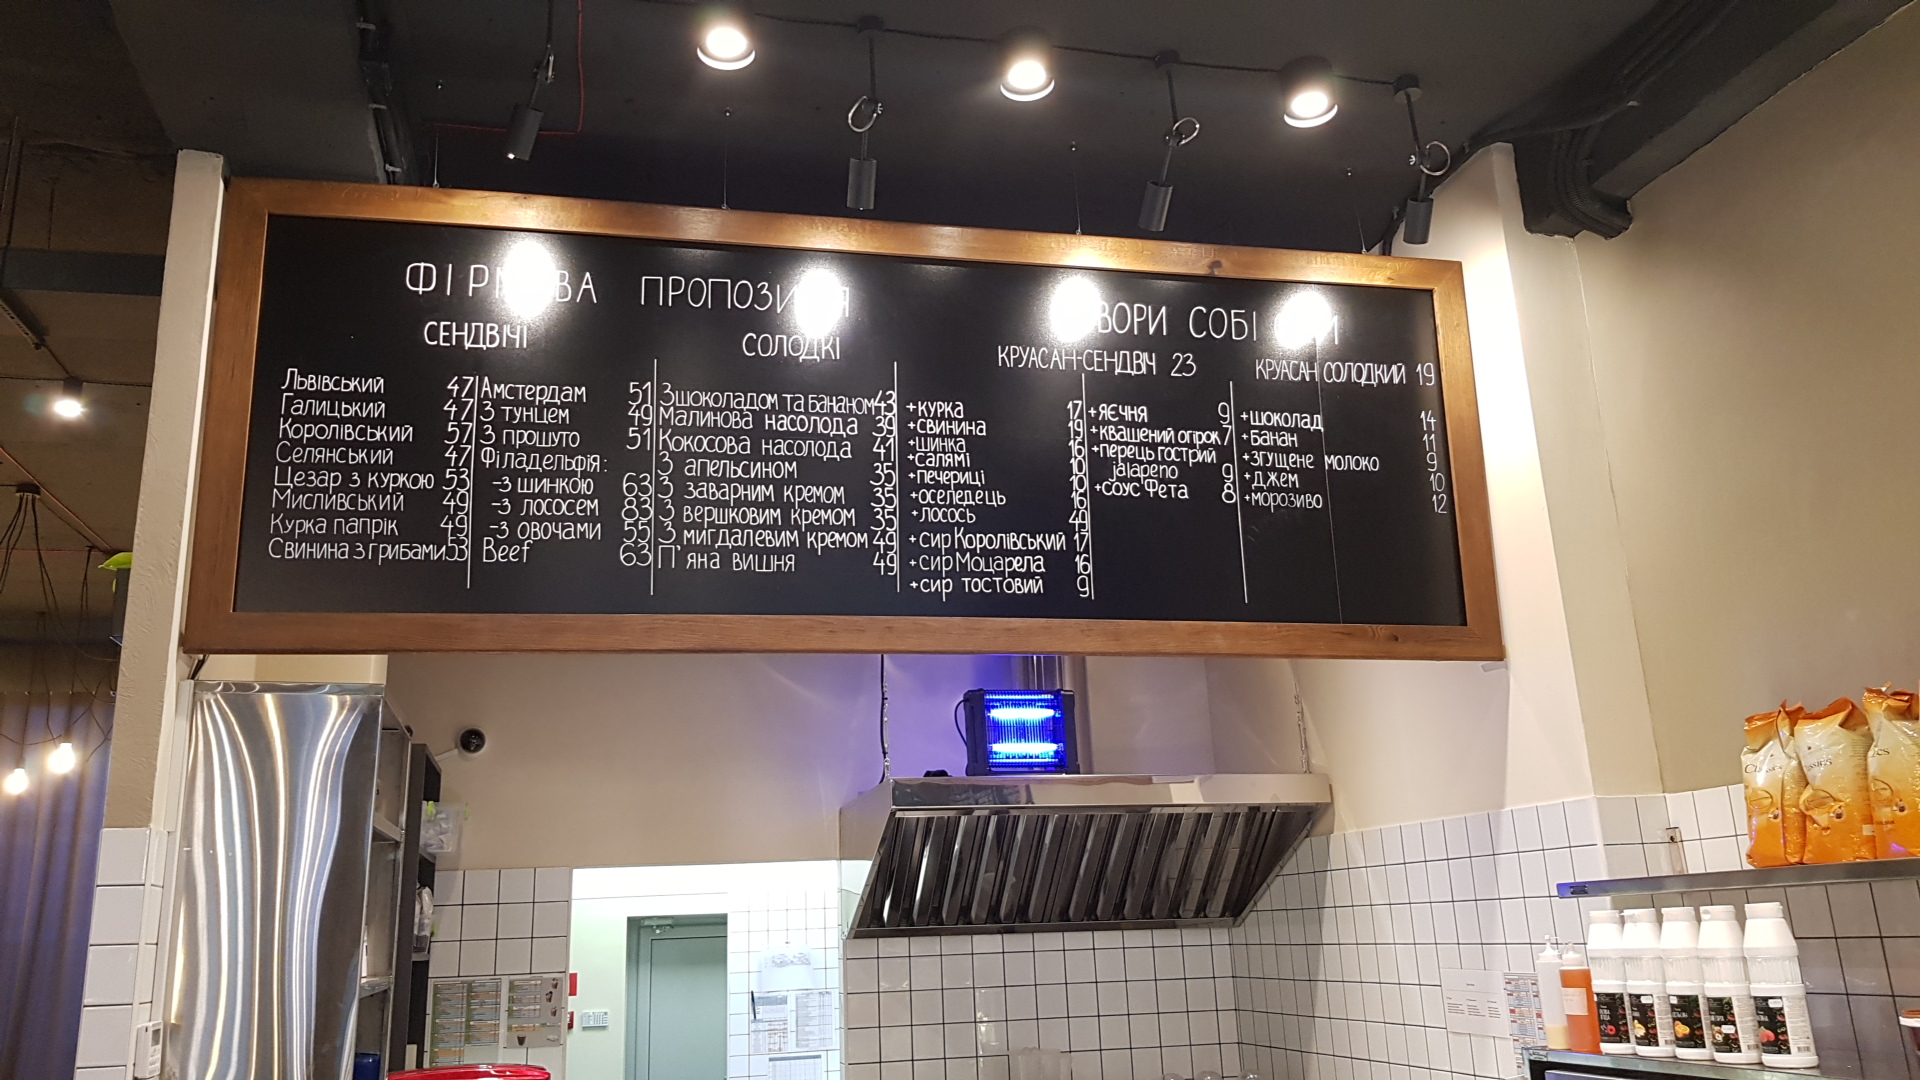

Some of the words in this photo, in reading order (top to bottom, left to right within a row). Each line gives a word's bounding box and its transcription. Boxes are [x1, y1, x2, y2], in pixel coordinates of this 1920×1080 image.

[406, 262, 597, 303] ФІРВА
[424, 321, 528, 350] СЕНДВІЧІ
[1189, 306, 1256, 341] СОБІ
[742, 332, 840, 362] СОЛОДКІ
[998, 345, 1157, 376] КРУАСАН-СЕНДВІЧ
[1170, 353, 1197, 377] 23
[1255, 359, 1318, 382] КРУАСАН
[1323, 361, 1406, 387] СОЛОДКИЙ
[1416, 362, 1435, 386] 19
[281, 368, 384, 393] Львівський
[447, 376, 474, 398] 47
[480, 376, 587, 405] Амстердам
[628, 381, 652, 406] 51
[281, 393, 385, 419] Галицький
[443, 398, 474, 421] 47
[500, 406, 570, 425] тунцем
[627, 403, 653, 426] 49
[782, 393, 804, 412] та
[808, 394, 875, 416] бананом
[874, 390, 896, 416] 43
[1066, 400, 1082, 420] 17
[1217, 402, 1230, 425] 9
[279, 417, 413, 444] Королівський
[444, 422, 473, 444] 57
[659, 406, 753, 429] Малинова
[764, 413, 858, 438] насолода
[872, 415, 896, 438] 39
[1068, 419, 1083, 439] 19
[1420, 410, 1437, 431] 14
[503, 429, 580, 449] прошуто
[626, 427, 651, 450] 51
[659, 428, 750, 454] Кокосова
[761, 439, 852, 461] насолода
[872, 437, 894, 461] 41
[1068, 438, 1085, 458] 16
[1177, 430, 1221, 449] огірок
[1222, 425, 1232, 446] 7
[1422, 433, 1436, 452] 11
[276, 441, 393, 465] Селянський
[444, 444, 472, 467] 47
[1069, 457, 1086, 475] 10
[1157, 446, 1217, 467] гострий
[1325, 455, 1379, 471] молоко
[1426, 451, 1438, 471] 9
[274, 465, 342, 494] Цезар
[367, 472, 434, 493] куркою
[442, 467, 470, 492] 53
[517, 477, 594, 494] шинкою
[622, 472, 652, 497] 63
[684, 458, 797, 478] апельсином
[870, 462, 896, 486] 35
[1069, 474, 1087, 491] 10
[1108, 461, 1178, 485] jalapeno
[1222, 463, 1233, 483] 9
[1430, 473, 1445, 492] 10
[272, 488, 404, 512] Мисливський
[442, 491, 469, 514] 49
[683, 482, 774, 506] заварним
[783, 484, 845, 509] кремом
[871, 487, 897, 509] 35
[1071, 490, 1087, 509] 16
[1144, 479, 1189, 499] Фета
[1221, 483, 1236, 503] 8
[1431, 493, 1447, 514] 12
[520, 499, 600, 516] лососем
[622, 497, 653, 521] 83
[683, 505, 781, 528] вершковим
[790, 508, 855, 532] кремом
[870, 508, 897, 532] 35
[1068, 509, 1088, 532] 49
[270, 513, 327, 539] Курка
[333, 517, 399, 539] папрік
[440, 514, 468, 537] 49
[517, 521, 601, 540] овочами
[623, 521, 651, 544] 55
[268, 537, 349, 559] Свинина
[368, 543, 446, 565] грибами
[446, 537, 469, 561] 53
[482, 537, 533, 563] Beef
[619, 542, 652, 566] 63
[683, 528, 799, 549] мигдалевим
[806, 531, 869, 555] кремом
[872, 531, 897, 554] 49
[954, 526, 1066, 553] Королівський
[1074, 532, 1089, 552] 17
[732, 553, 795, 572] вишня
[872, 552, 897, 575] 49
[956, 551, 1045, 577] Моцарела
[1075, 554, 1091, 575] 16
[961, 576, 1043, 594] тостовий
[1077, 575, 1090, 598] 9
